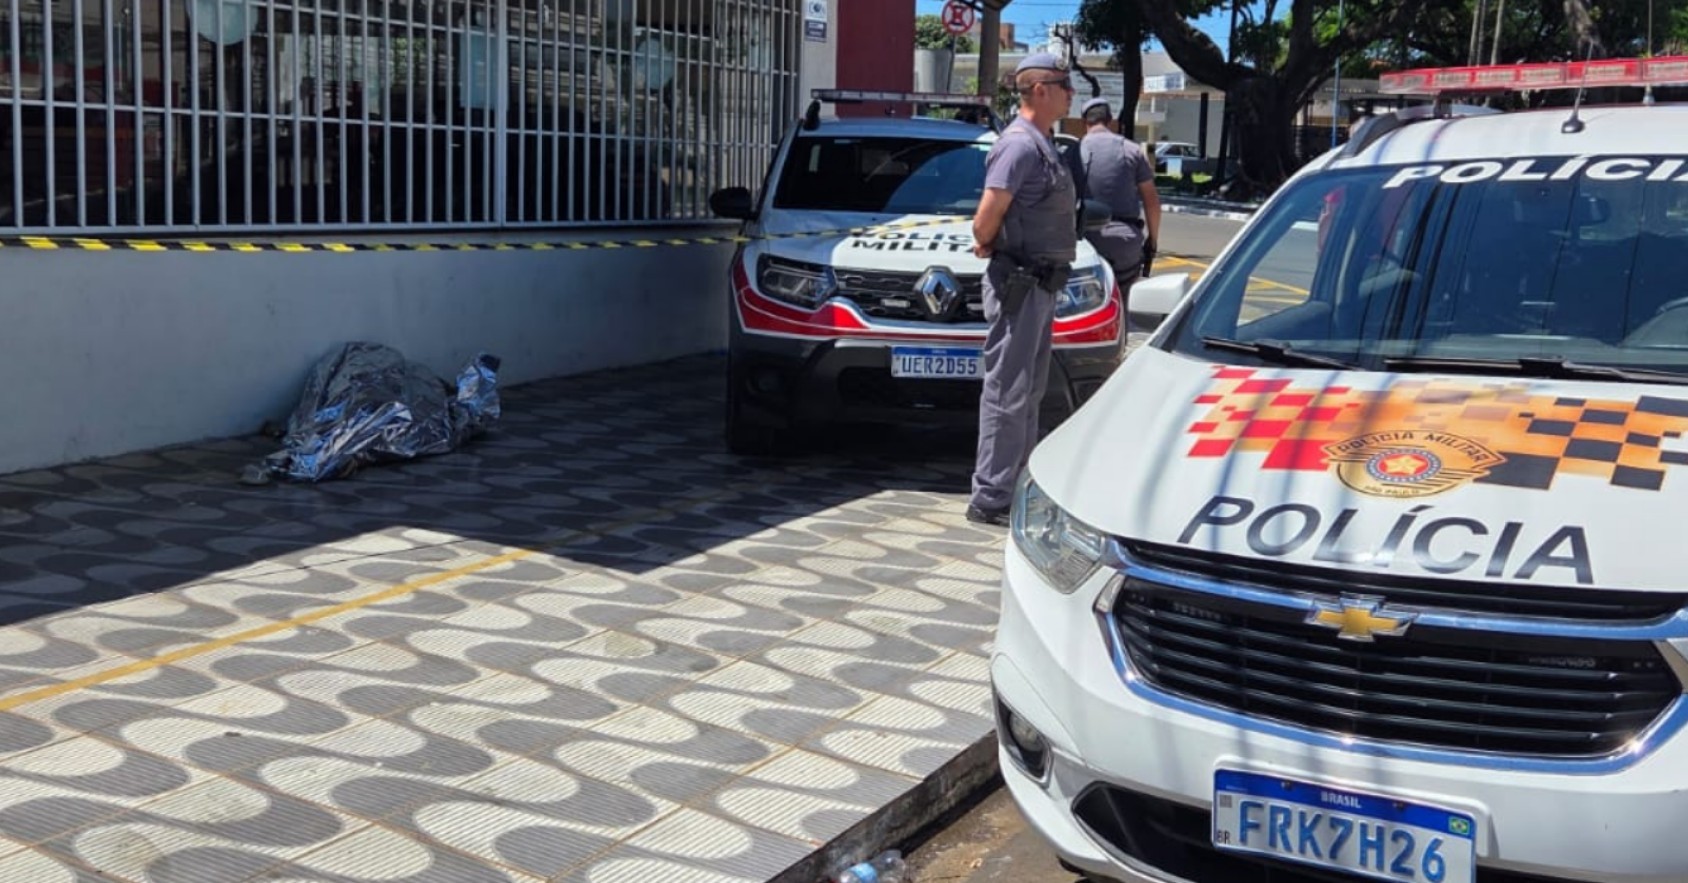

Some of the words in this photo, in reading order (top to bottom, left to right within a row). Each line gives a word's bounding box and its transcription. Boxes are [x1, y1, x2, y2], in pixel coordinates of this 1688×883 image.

[902, 357, 977, 375] UER2D55
[1424, 432, 1488, 463] MILITAR
[1177, 495, 1595, 584] POLÍCIA
[1321, 791, 1362, 809] BRASIL
[1216, 829, 1231, 845] BR
[1239, 800, 1446, 883] FRK7H26
